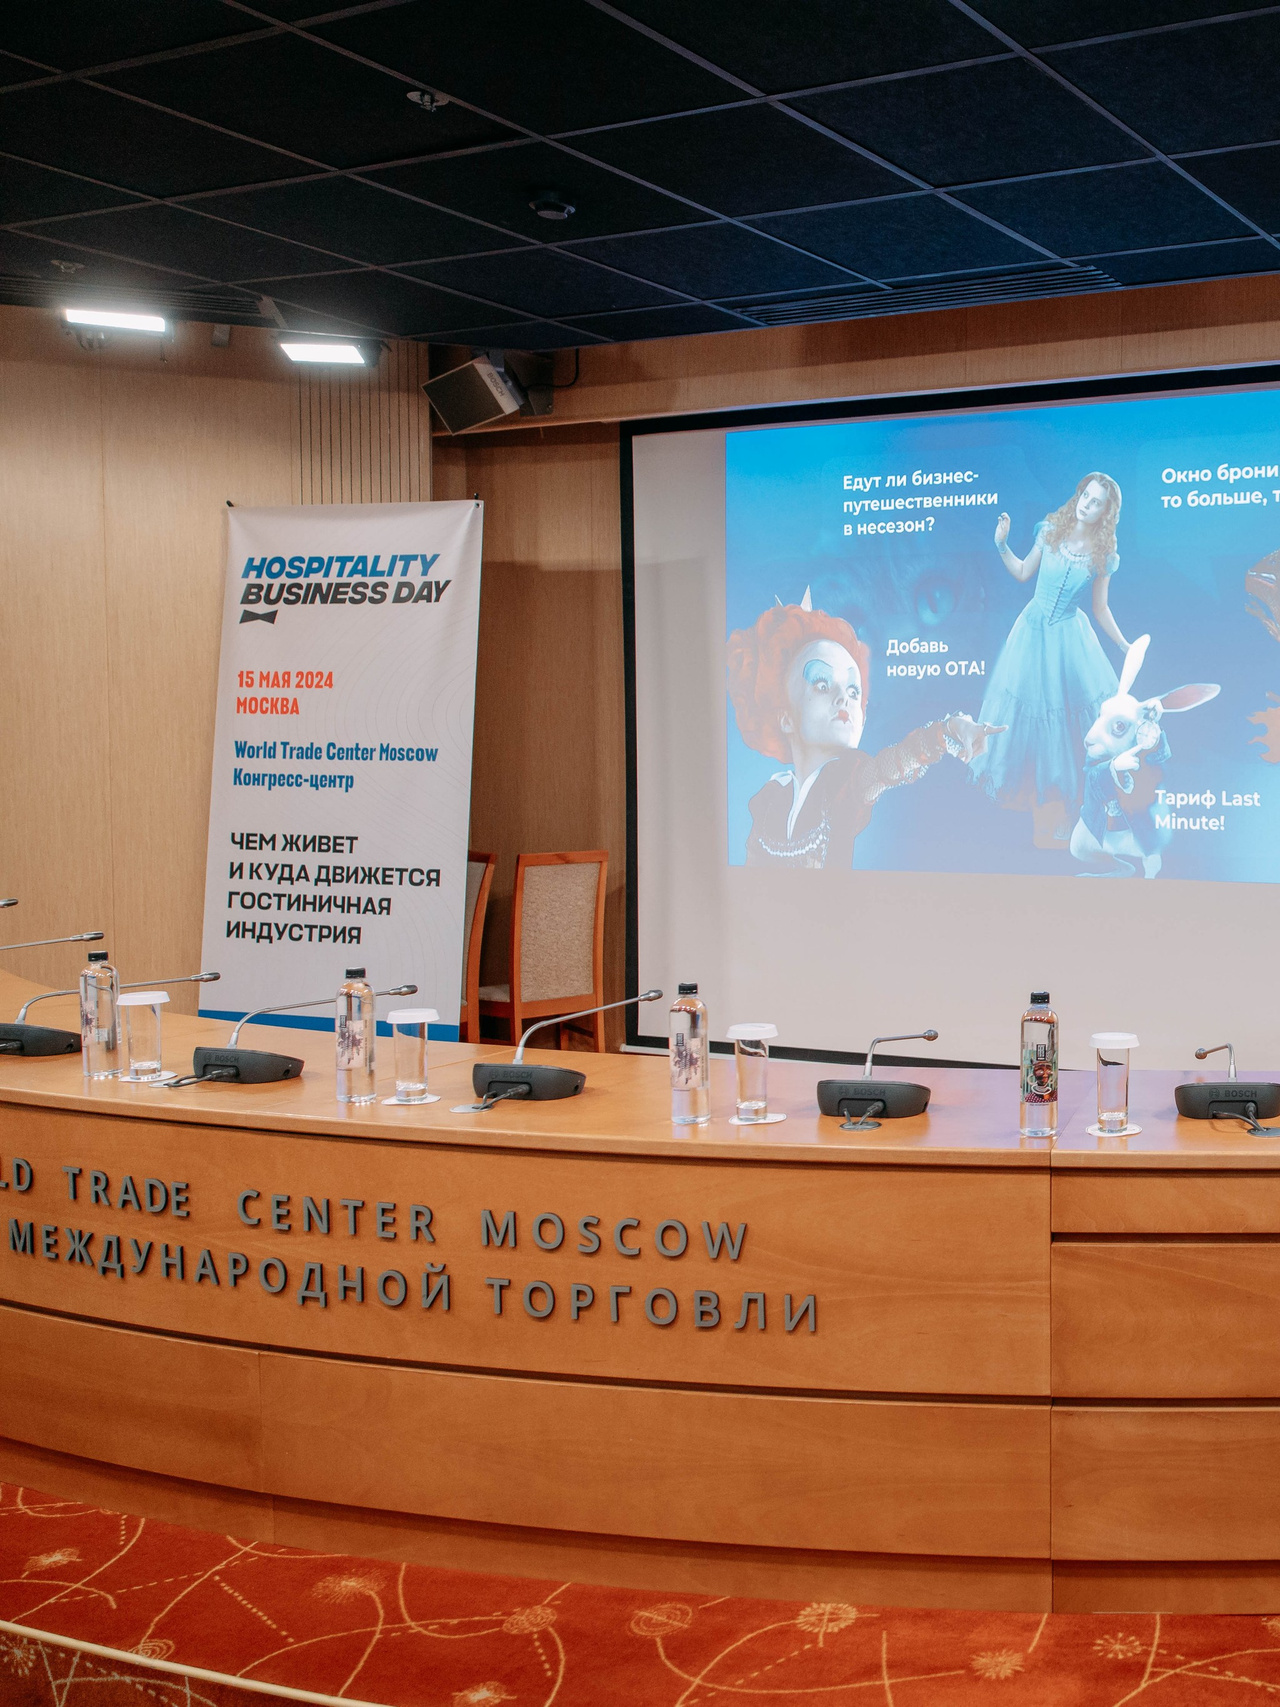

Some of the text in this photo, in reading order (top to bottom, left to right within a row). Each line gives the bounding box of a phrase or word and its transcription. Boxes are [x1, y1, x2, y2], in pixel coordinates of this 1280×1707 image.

[487, 372, 505, 397] BOSCH
[843, 469, 979, 492] Едут ли бизнес-
[1161, 468, 1212, 484] Окно
[843, 492, 998, 515] путешественники
[1161, 494, 1182, 508] то
[1187, 490, 1268, 508] больше,
[843, 516, 935, 536] в несезон?
[241, 553, 440, 580] HOSPITALITY
[239, 580, 451, 606] BUSINESS DAY
[886, 637, 949, 657] Добавь
[238, 670, 334, 690] 15 МАЯ 2024
[886, 662, 941, 680] новую
[236, 697, 300, 715] МОСКВА
[234, 740, 439, 763] World Trade Center Moscow
[233, 768, 354, 792] Конгресс-центр
[1154, 789, 1261, 809] Тариф Last
[1154, 812, 1225, 830] Minute!
[230, 832, 358, 854] ЧЕМ ЖИВЕТ
[229, 861, 441, 888] И КУДА ДВИЖЕТСЯ
[227, 891, 392, 916] ГОСТИНИЧНАЯ
[226, 920, 362, 944] ИНДУСТРИЯ
[214, 1054, 239, 1063] BOSCH
[853, 1087, 886, 1096] BOSCH
[1224, 1090, 1257, 1098] BOSCH
[62, 1166, 190, 1217] TRADE
[237, 1189, 435, 1243] CENTER
[480, 1209, 748, 1261] MOSCOW
[8, 1218, 818, 1333] МЕЖДУНАРОДНОЙ ТОРГОВЛИ
